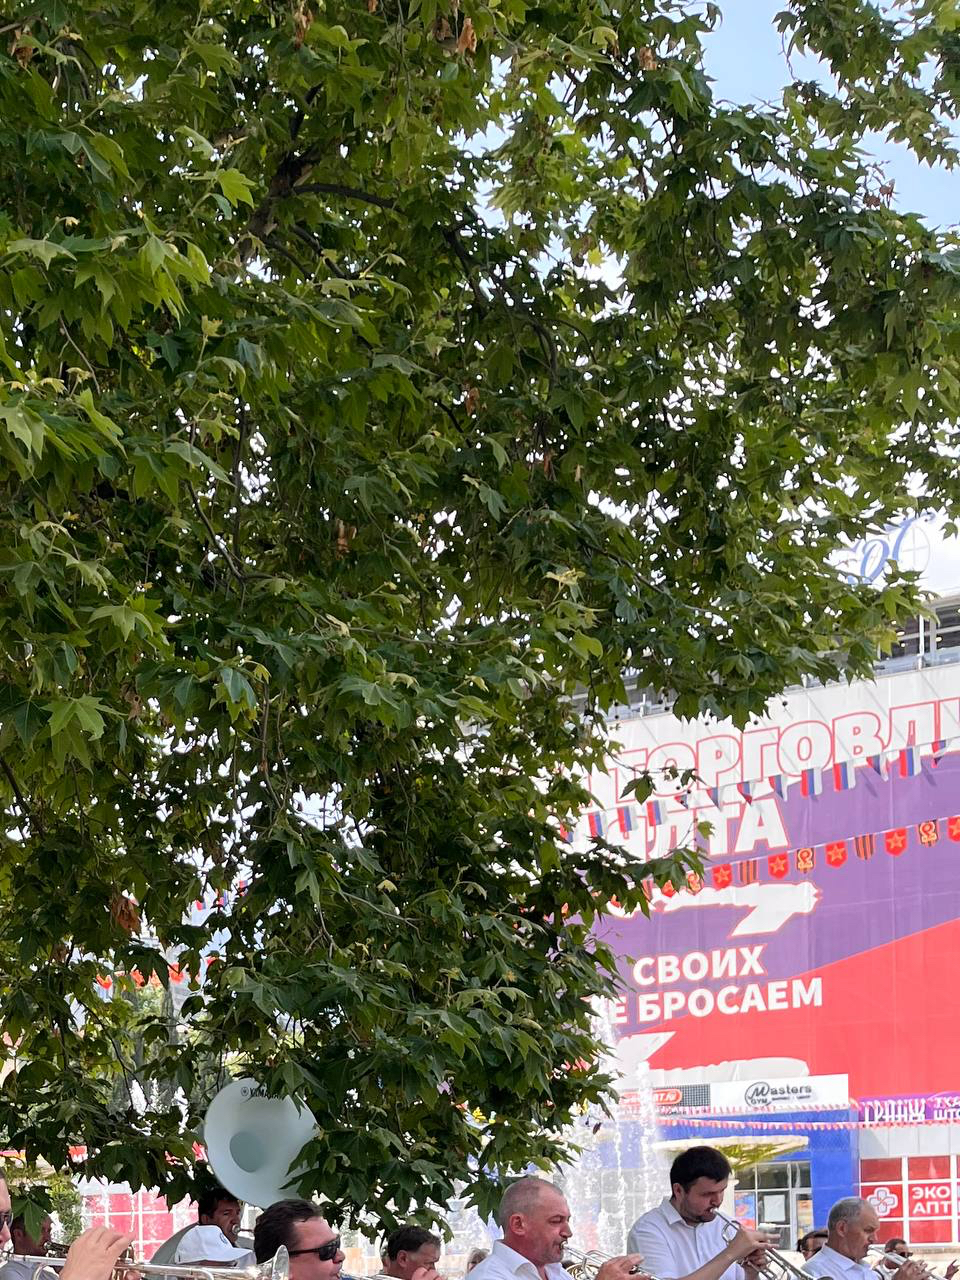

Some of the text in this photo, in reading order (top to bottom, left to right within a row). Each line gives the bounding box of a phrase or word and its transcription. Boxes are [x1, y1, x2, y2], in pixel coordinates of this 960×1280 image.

[633, 946, 765, 986] СВОИХ
[638, 977, 823, 1022] БРОСАЕМ
[746, 1083, 812, 1099] Masters
[912, 1200, 952, 1214] АПТ
